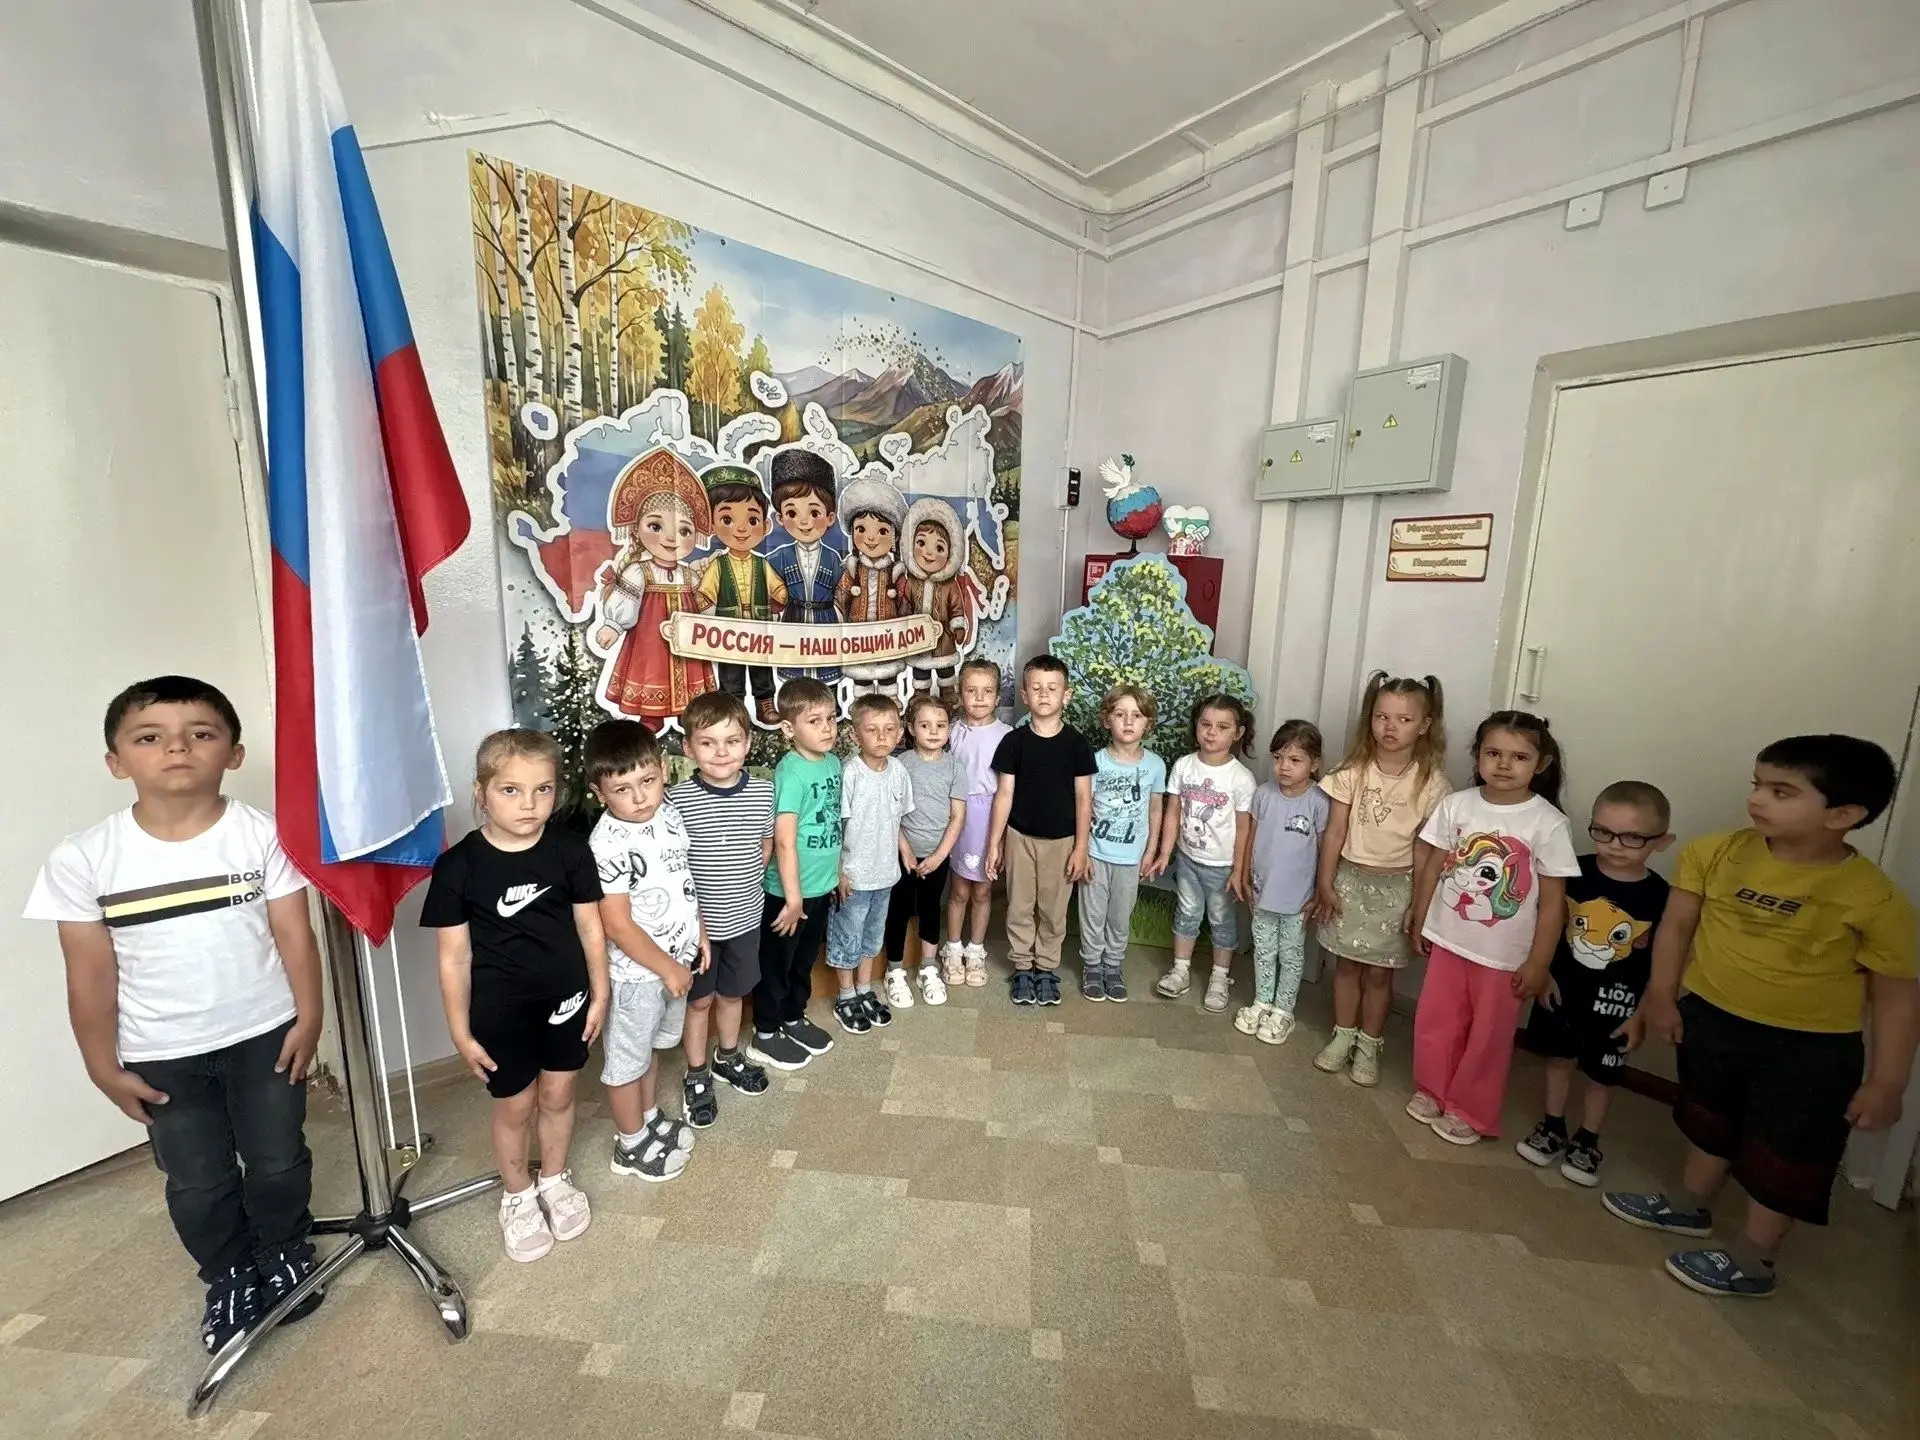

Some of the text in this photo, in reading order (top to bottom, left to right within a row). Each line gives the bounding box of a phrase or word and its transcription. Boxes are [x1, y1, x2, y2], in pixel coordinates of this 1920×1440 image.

[691, 622, 775, 655] РОССИЯ
[799, 637, 837, 656] НАШ
[840, 629, 895, 655] ОБЩИЙ
[897, 624, 926, 649] ДОМ
[230, 869, 265, 885] BOS
[504, 883, 538, 903] NIKE
[557, 991, 583, 1014] NIKE
